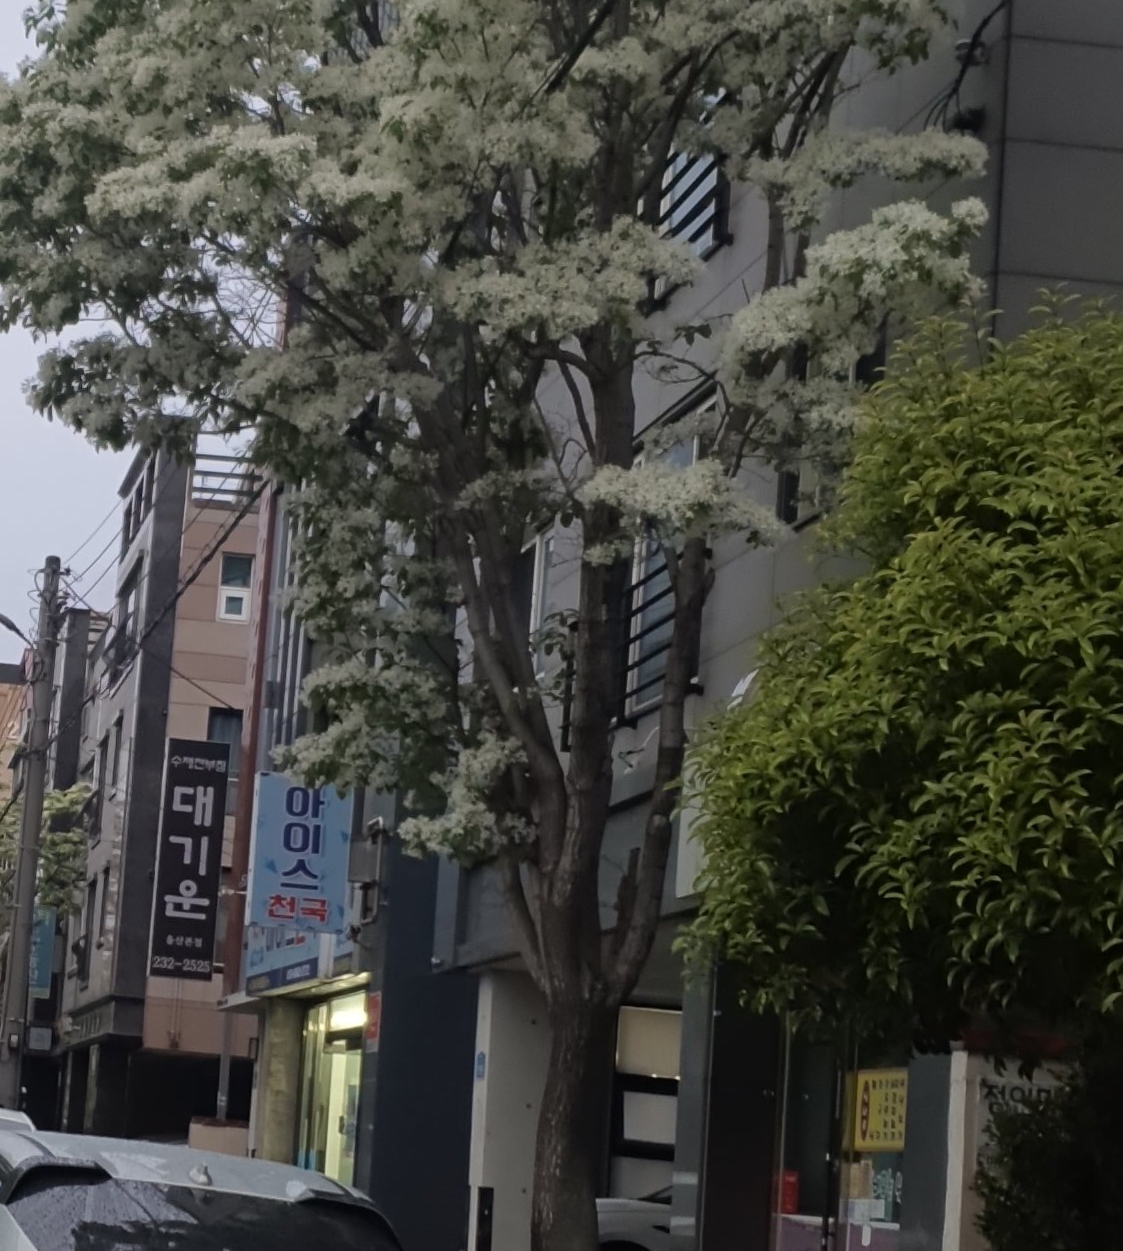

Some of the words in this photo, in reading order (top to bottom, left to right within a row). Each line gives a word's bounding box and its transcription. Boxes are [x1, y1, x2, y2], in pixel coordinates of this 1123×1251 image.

[164, 785, 214, 920] 대기운
[280, 786, 325, 890] 아이스
[268, 894, 327, 922] 천국
[152, 955, 211, 973] 232-2525
